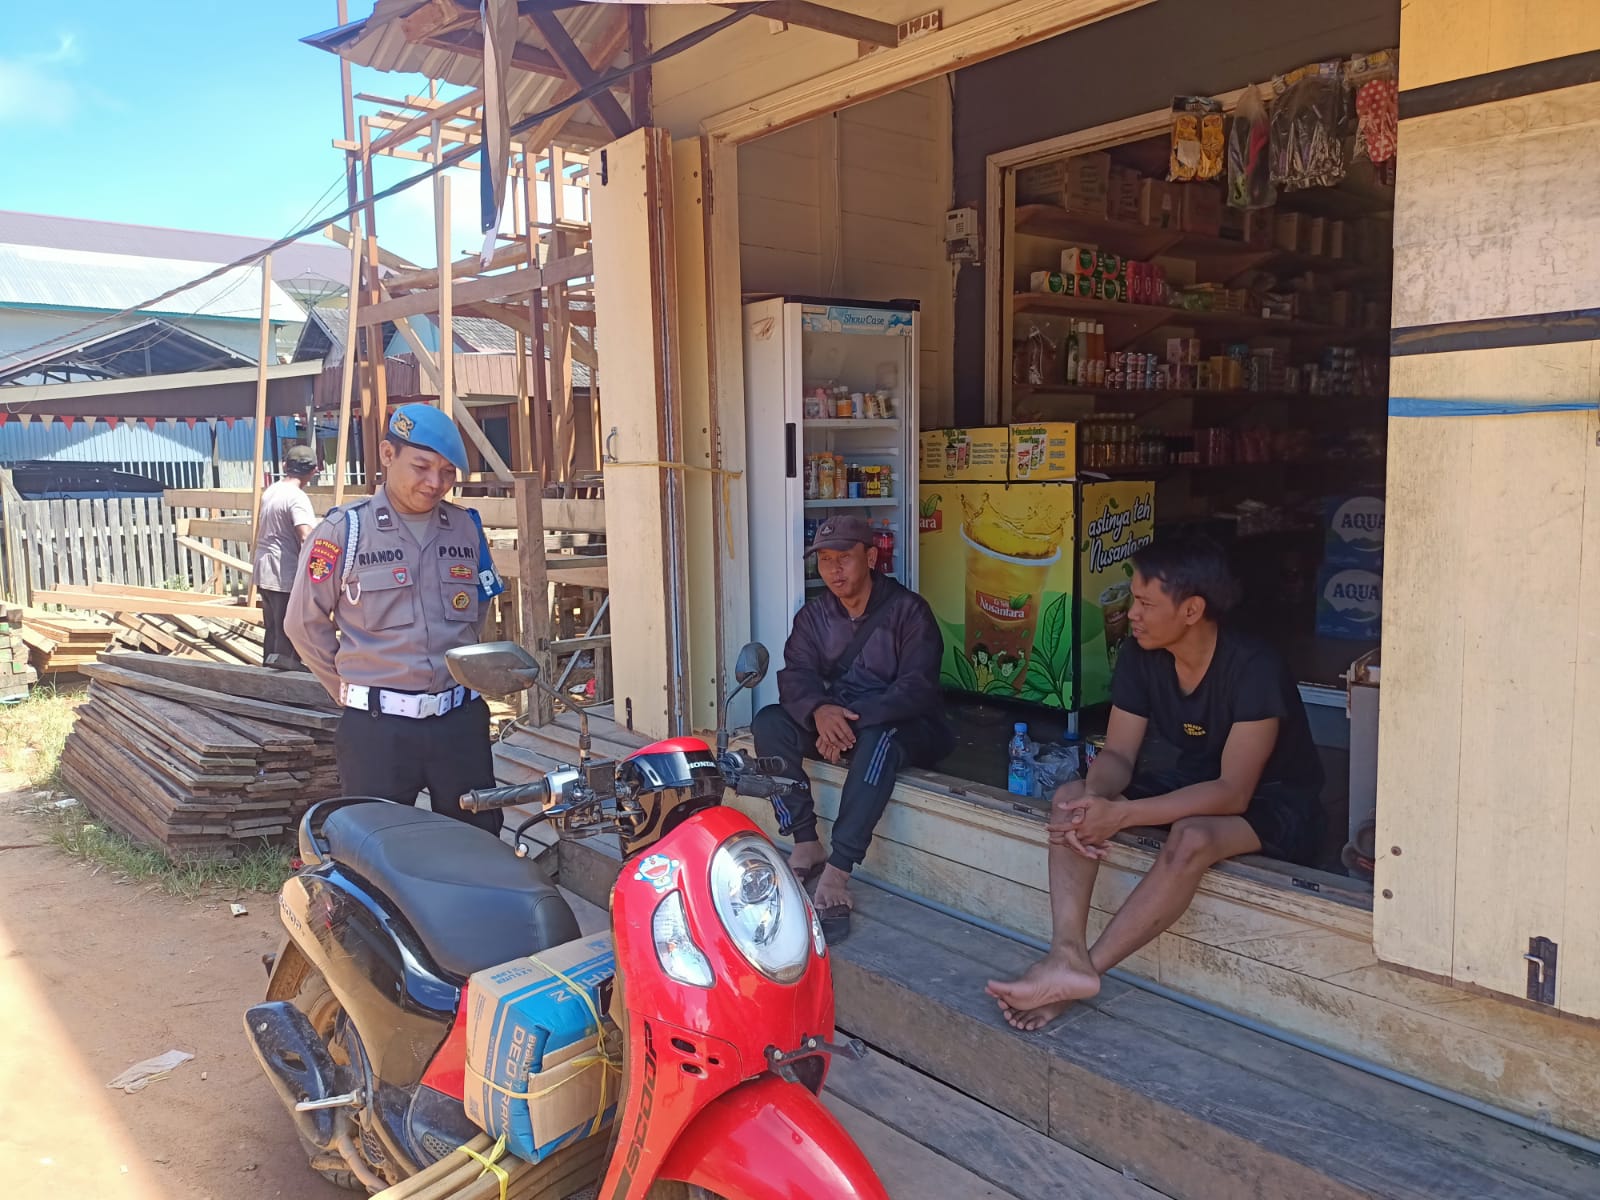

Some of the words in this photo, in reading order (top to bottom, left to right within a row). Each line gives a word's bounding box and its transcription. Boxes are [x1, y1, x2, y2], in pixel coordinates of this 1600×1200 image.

[1088, 505, 1130, 542] aslinya
[1133, 492, 1151, 523] teh
[359, 549, 404, 566] RIANDO
[439, 546, 474, 558] POLRI
[1332, 583, 1379, 602] AQUA
[980, 596, 1025, 618] Nusantara
[689, 761, 717, 769] HONDA
[505, 1025, 526, 1077] DEO
